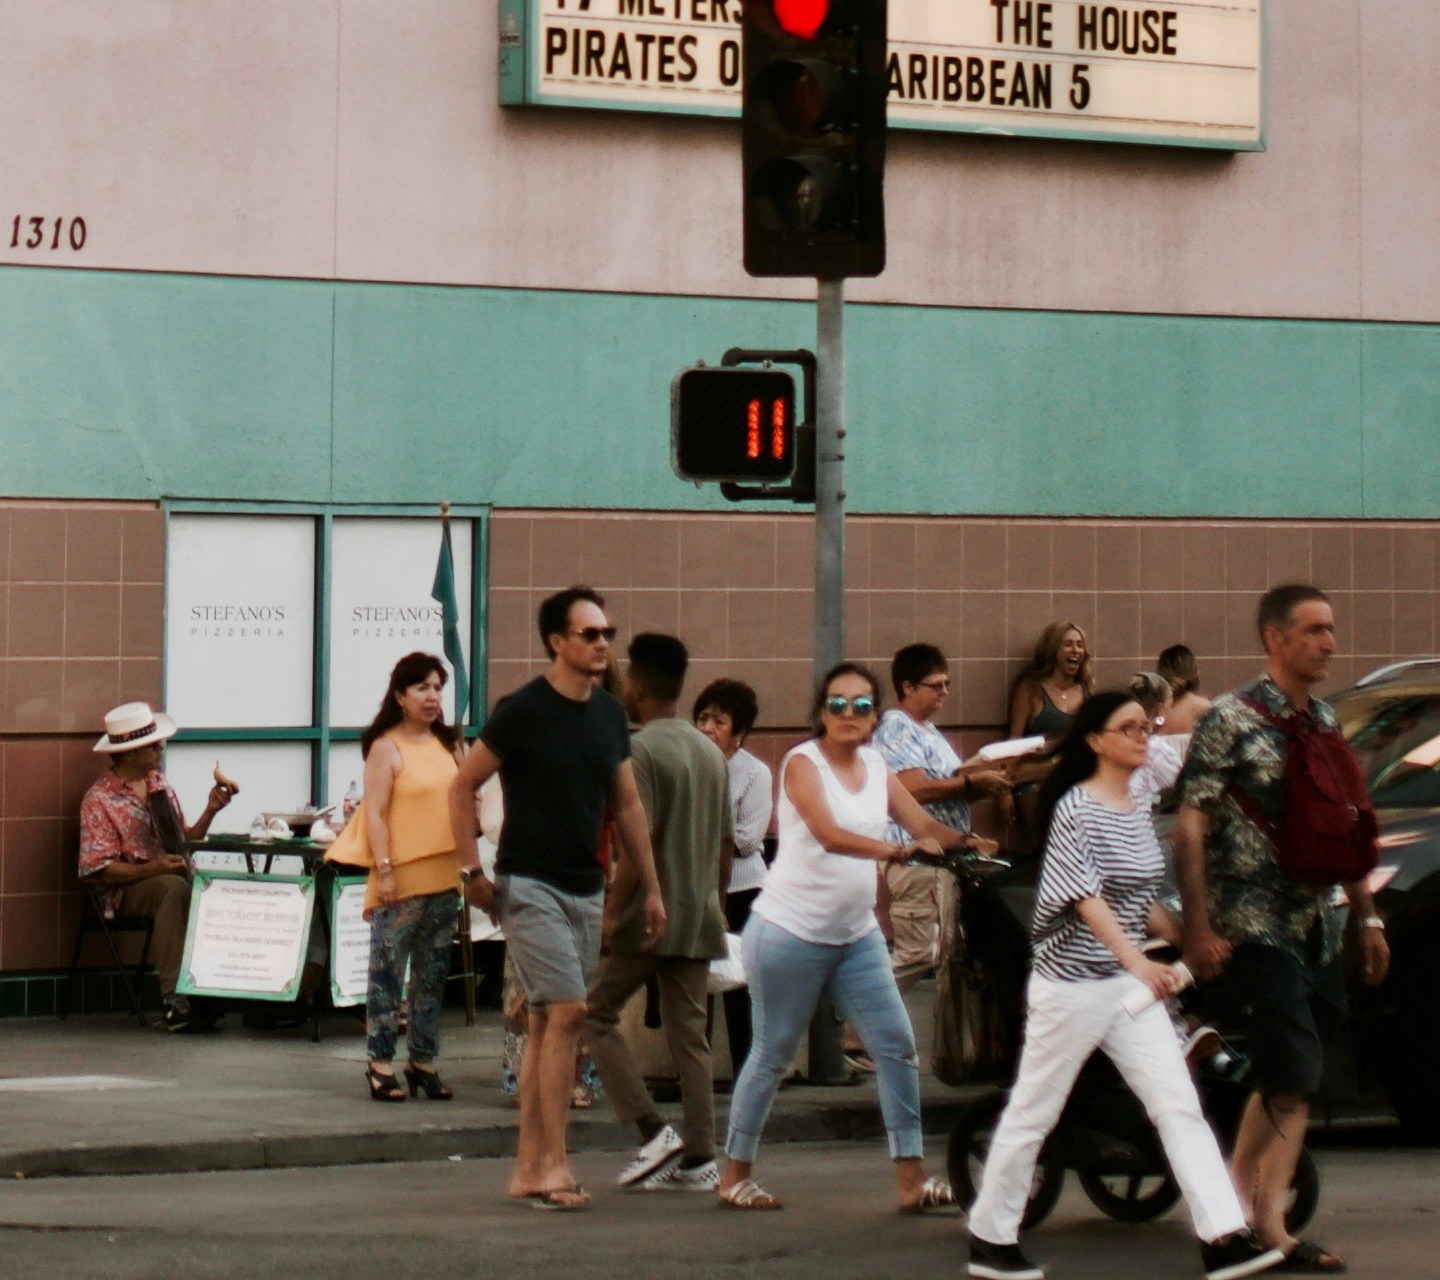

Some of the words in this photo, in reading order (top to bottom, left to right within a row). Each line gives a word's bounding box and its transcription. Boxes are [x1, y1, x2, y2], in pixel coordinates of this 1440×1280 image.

[1077, 4, 1178, 56] HOUSE
[545, 26, 698, 84] PIRATES
[719, 39, 740, 87] O
[886, 52, 1053, 110] ARIBBEAN
[1069, 63, 1091, 111] 5
[9, 214, 87, 251] 1310
[747, 397, 784, 458] 11
[191, 605, 285, 621] STEFANO'S
[352, 606, 443, 621] STEFANO'S
[191, 627, 284, 637] PIZZERIA
[352, 628, 443, 637] PIZZERIA
